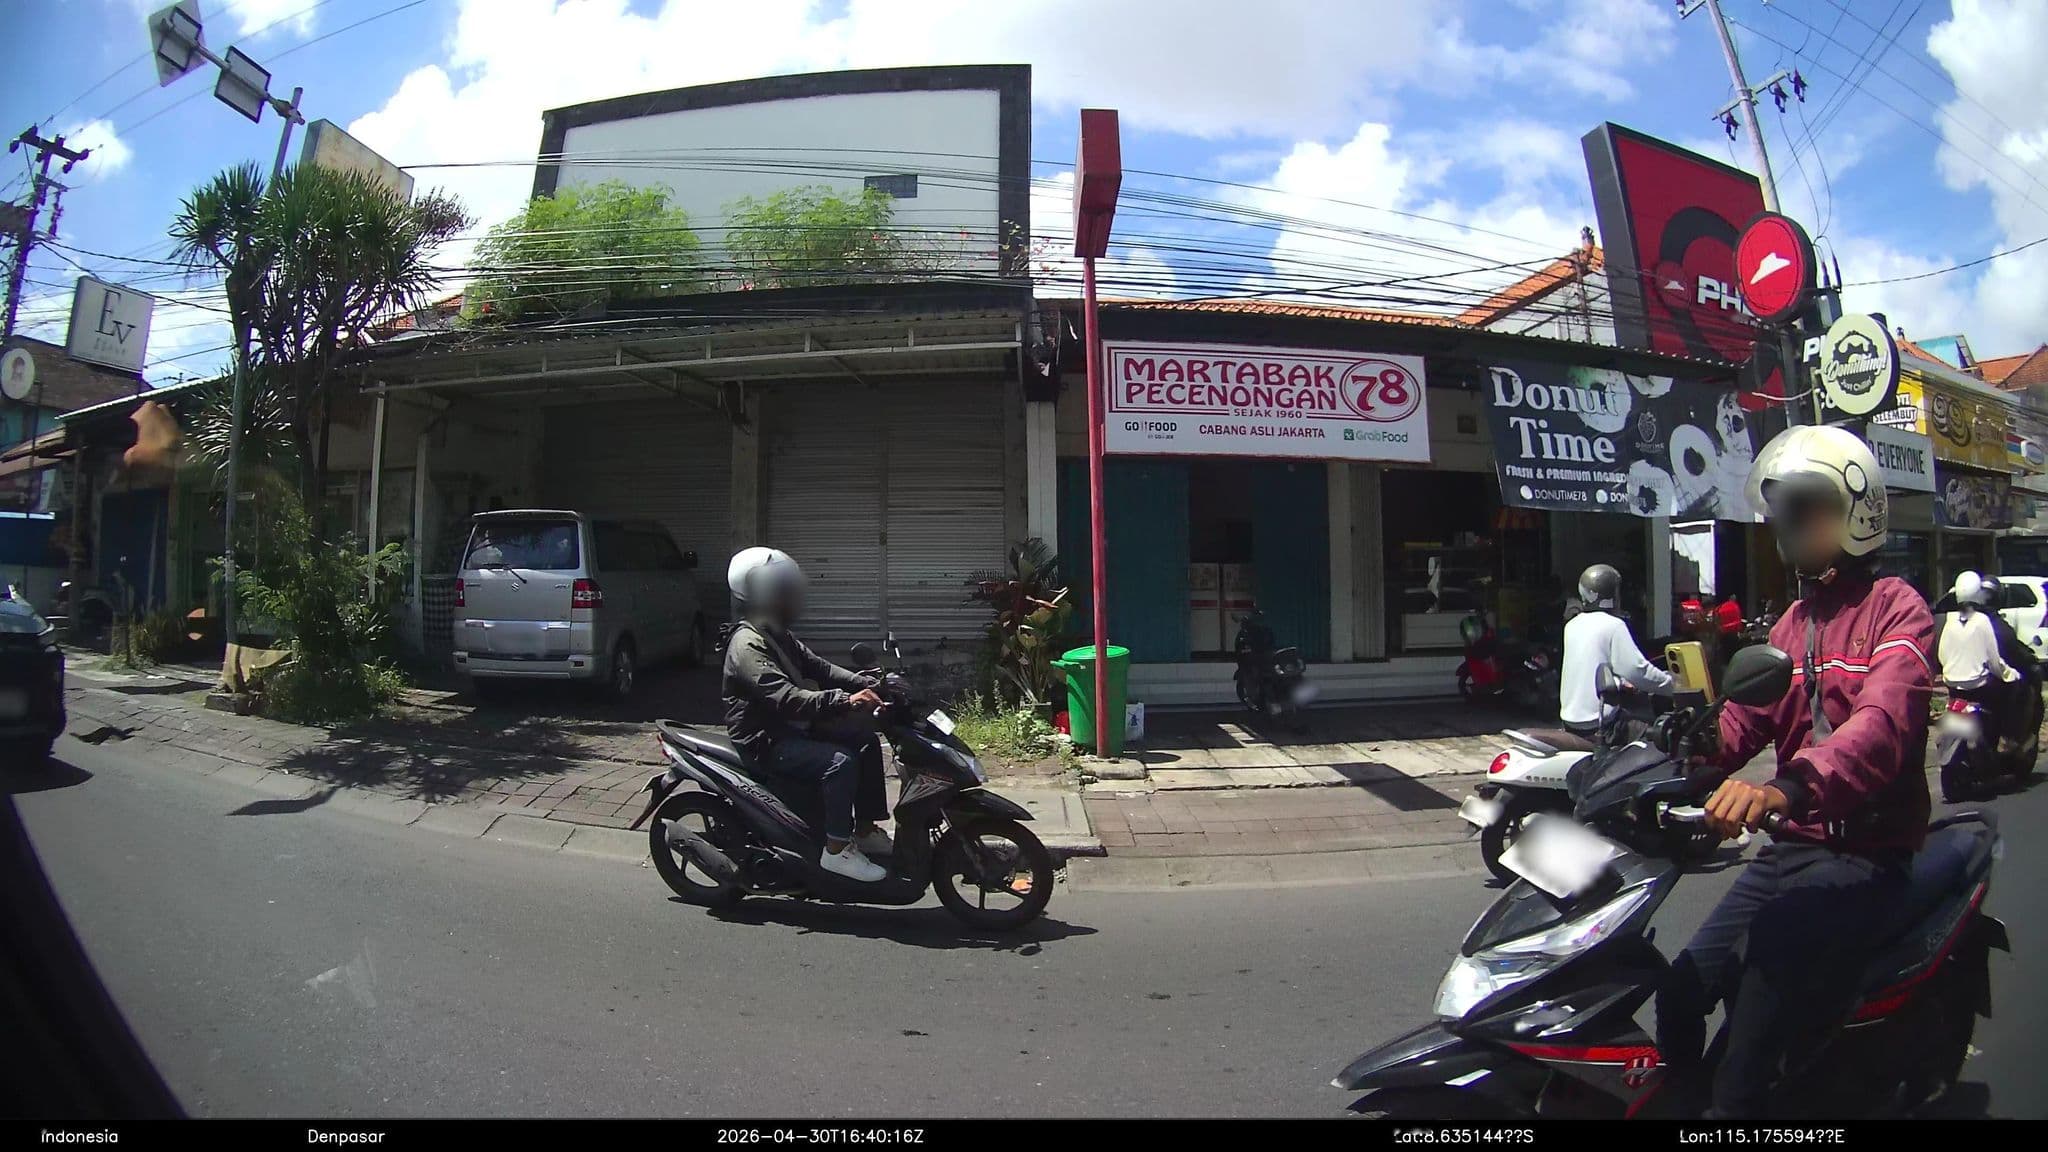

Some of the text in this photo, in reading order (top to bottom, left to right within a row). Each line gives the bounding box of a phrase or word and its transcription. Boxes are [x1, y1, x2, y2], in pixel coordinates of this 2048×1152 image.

[1697, 275, 1756, 317] PH
[1803, 334, 1826, 363] P
[1124, 357, 1336, 389] MARTABAK
[1126, 382, 1337, 410] PECENONGAN
[1350, 368, 1409, 412] 78
[1488, 366, 1619, 416] Donut
[1148, 421, 1178, 432] FOOD
[1234, 408, 1303, 419] SEJAK 1960
[1875, 408, 1917, 423] SELEMBUT
[1199, 424, 1325, 439] CABANG ASLI JAKARTA
[1355, 430, 1408, 443] GrabFood
[1508, 416, 1616, 463] Time
[1876, 440, 1926, 475] EVERYONE
[1535, 466, 1545, 479] &
[1546, 467, 1593, 482] PREMIUM
[1534, 488, 1588, 502] DONUTIME78
